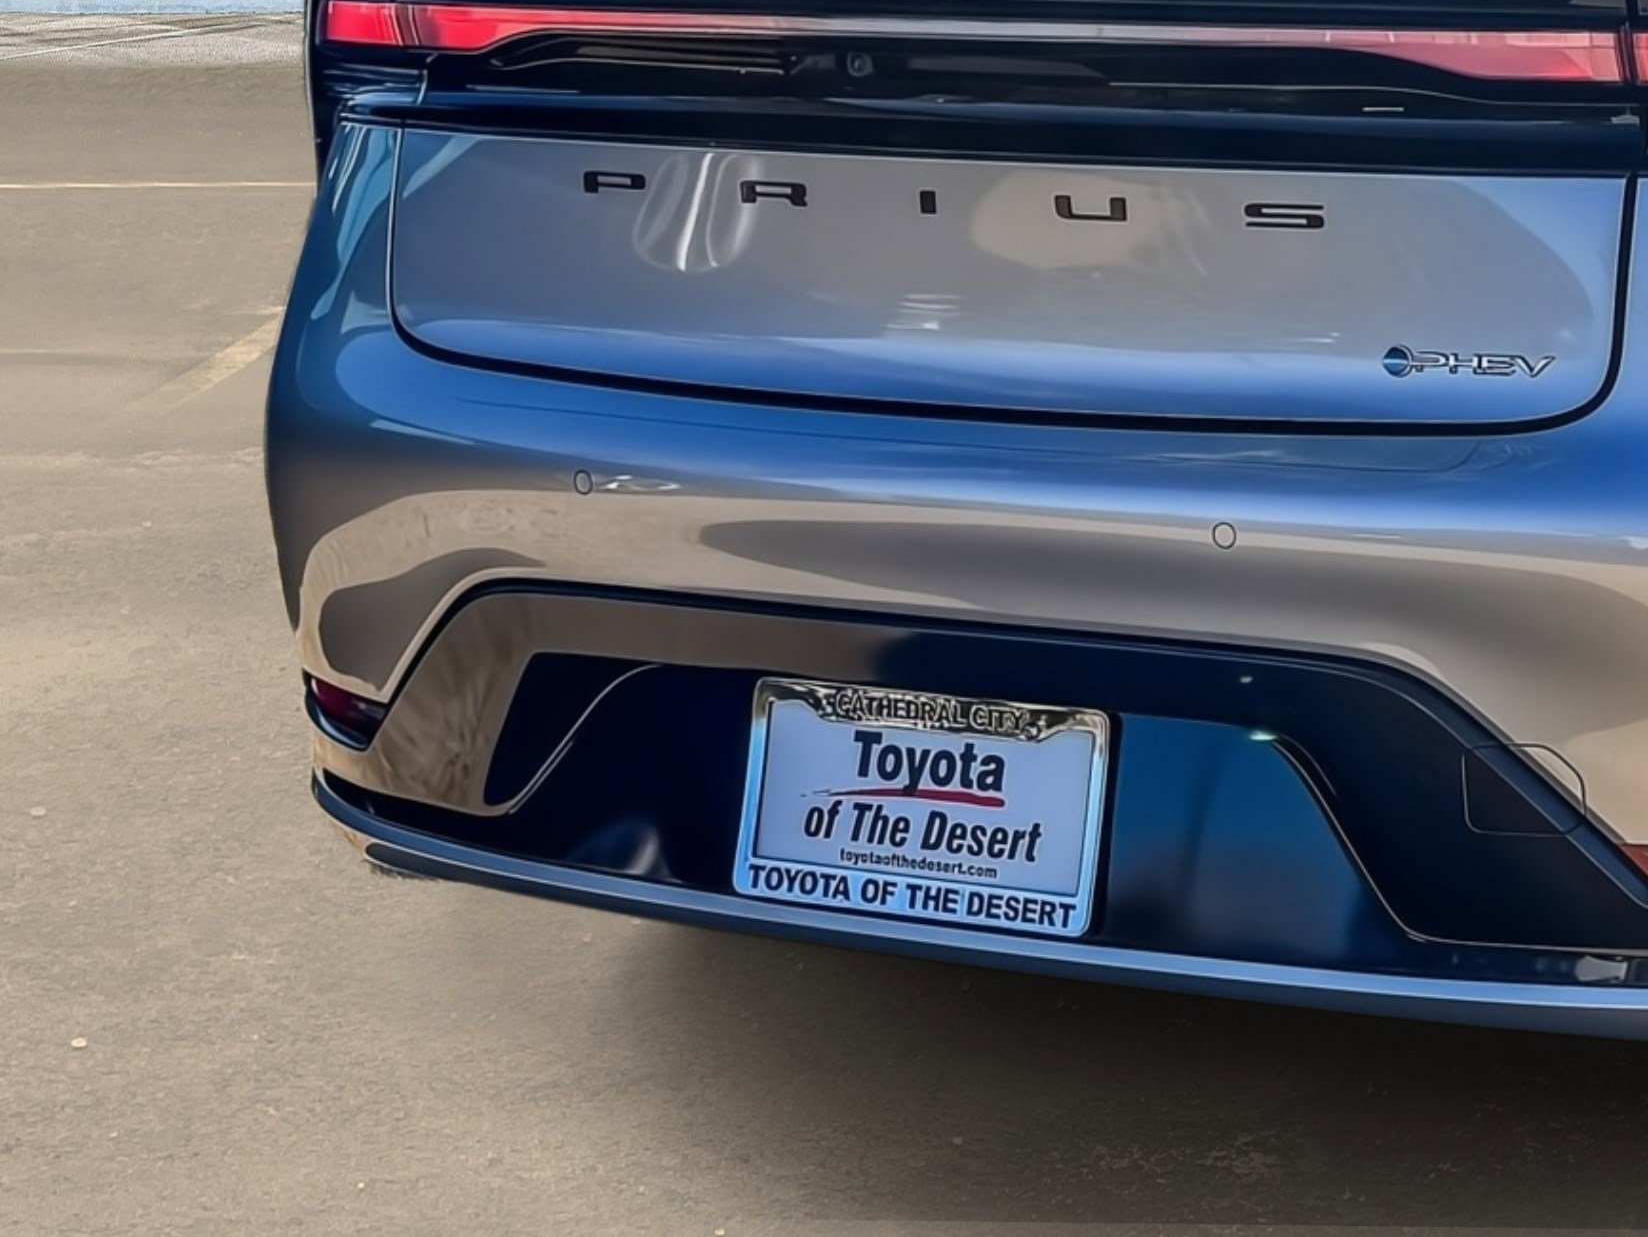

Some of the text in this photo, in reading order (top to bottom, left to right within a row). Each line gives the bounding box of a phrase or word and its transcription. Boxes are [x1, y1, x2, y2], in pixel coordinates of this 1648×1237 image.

[583, 170, 1325, 230] PRIUS
[1409, 350, 1557, 379] PHEV
[835, 690, 1024, 731] CATHEDRAL CITY
[853, 730, 1006, 795] Toyota
[803, 800, 1042, 863] of The Desert
[839, 847, 998, 879] toyotaofthedesert.com
[748, 864, 1077, 929] TOYOTA OF THE DESERT
